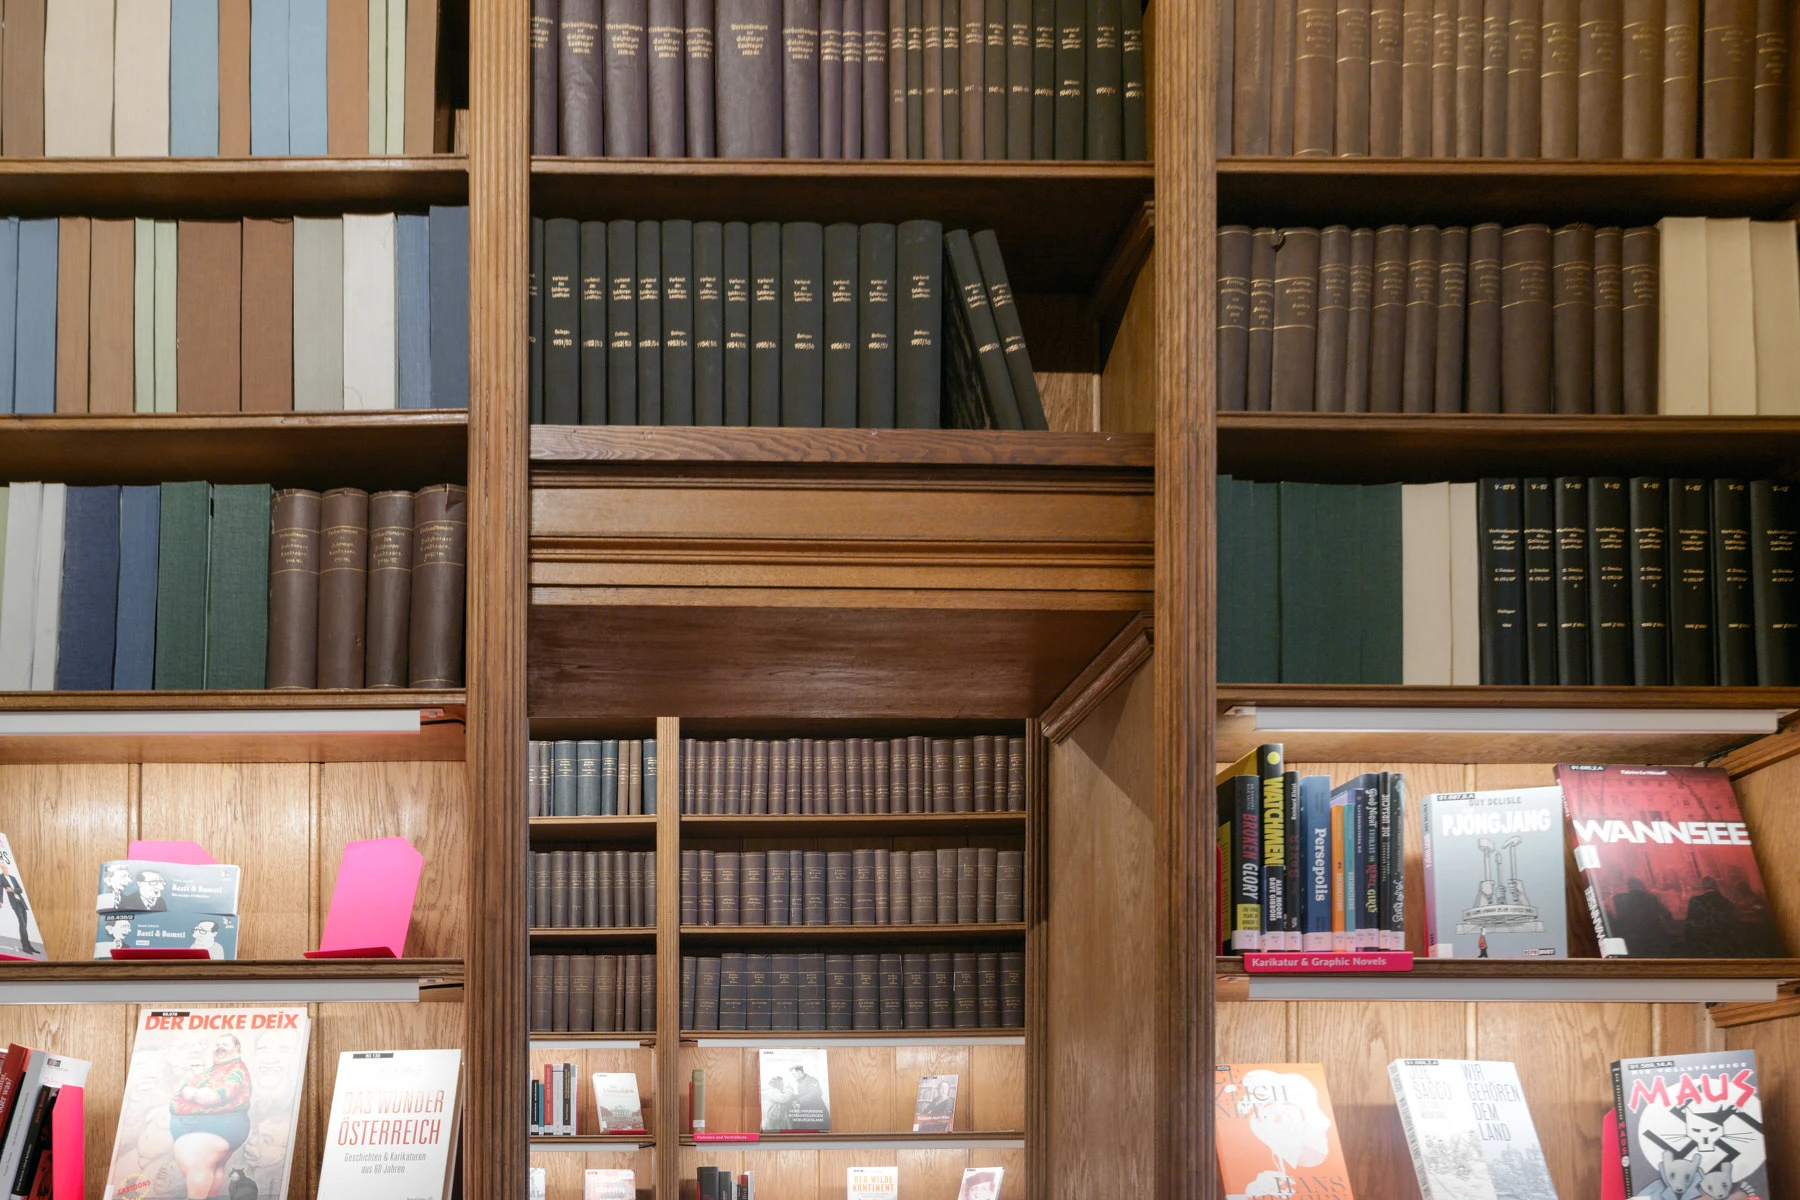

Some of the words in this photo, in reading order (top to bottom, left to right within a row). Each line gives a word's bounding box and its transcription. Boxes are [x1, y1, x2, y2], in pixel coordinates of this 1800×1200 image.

[1469, 799, 1484, 807] GUY
[1488, 796, 1522, 806] DELISLE
[1263, 776, 1285, 867] WATCHMEN
[1441, 807, 1552, 837] PJÖNGJANG
[1242, 813, 1258, 860] BROKEN
[1572, 819, 1752, 846] WANNSEE
[1314, 828, 1328, 902] Persepolis
[171, 883, 190, 893] Basti
[191, 884, 197, 892] &
[1242, 862, 1259, 900] GLORY
[1269, 894, 1277, 922] GIBBONS
[136, 929, 154, 937] Basti
[154, 930, 161, 938] &
[162, 930, 186, 939] Bumsti
[1252, 956, 1298, 966] Karikatur
[1301, 958, 1308, 966] &
[1312, 956, 1350, 968] Graphic
[1353, 956, 1387, 965] Novels
[144, 1015, 184, 1031] DER
[188, 1014, 247, 1030] DICKE
[1460, 1063, 1486, 1081] WIR
[1412, 1081, 1452, 1100] SACCO
[1466, 1081, 1521, 1102] GEHÖREN
[1627, 1069, 1757, 1114] MAUS
[342, 1090, 374, 1115] DAS
[377, 1089, 445, 1114] WUNDER
[1472, 1102, 1500, 1121] DEM
[337, 1116, 441, 1146] ÖSTERREICH
[1478, 1123, 1512, 1142] LAND
[1618, 1121, 1628, 1155] MAUS
[344, 1151, 382, 1163] Geschichten
[383, 1152, 388, 1162] &
[389, 1151, 427, 1162] Karikaturen
[361, 1165, 373, 1174] aus
[383, 1164, 405, 1174] Jahren
[852, 1183, 895, 1193] KONTINENT
[853, 1175, 869, 1184] DER
[870, 1175, 893, 1184] WILDE
[1274, 1175, 1346, 1194] HANS
